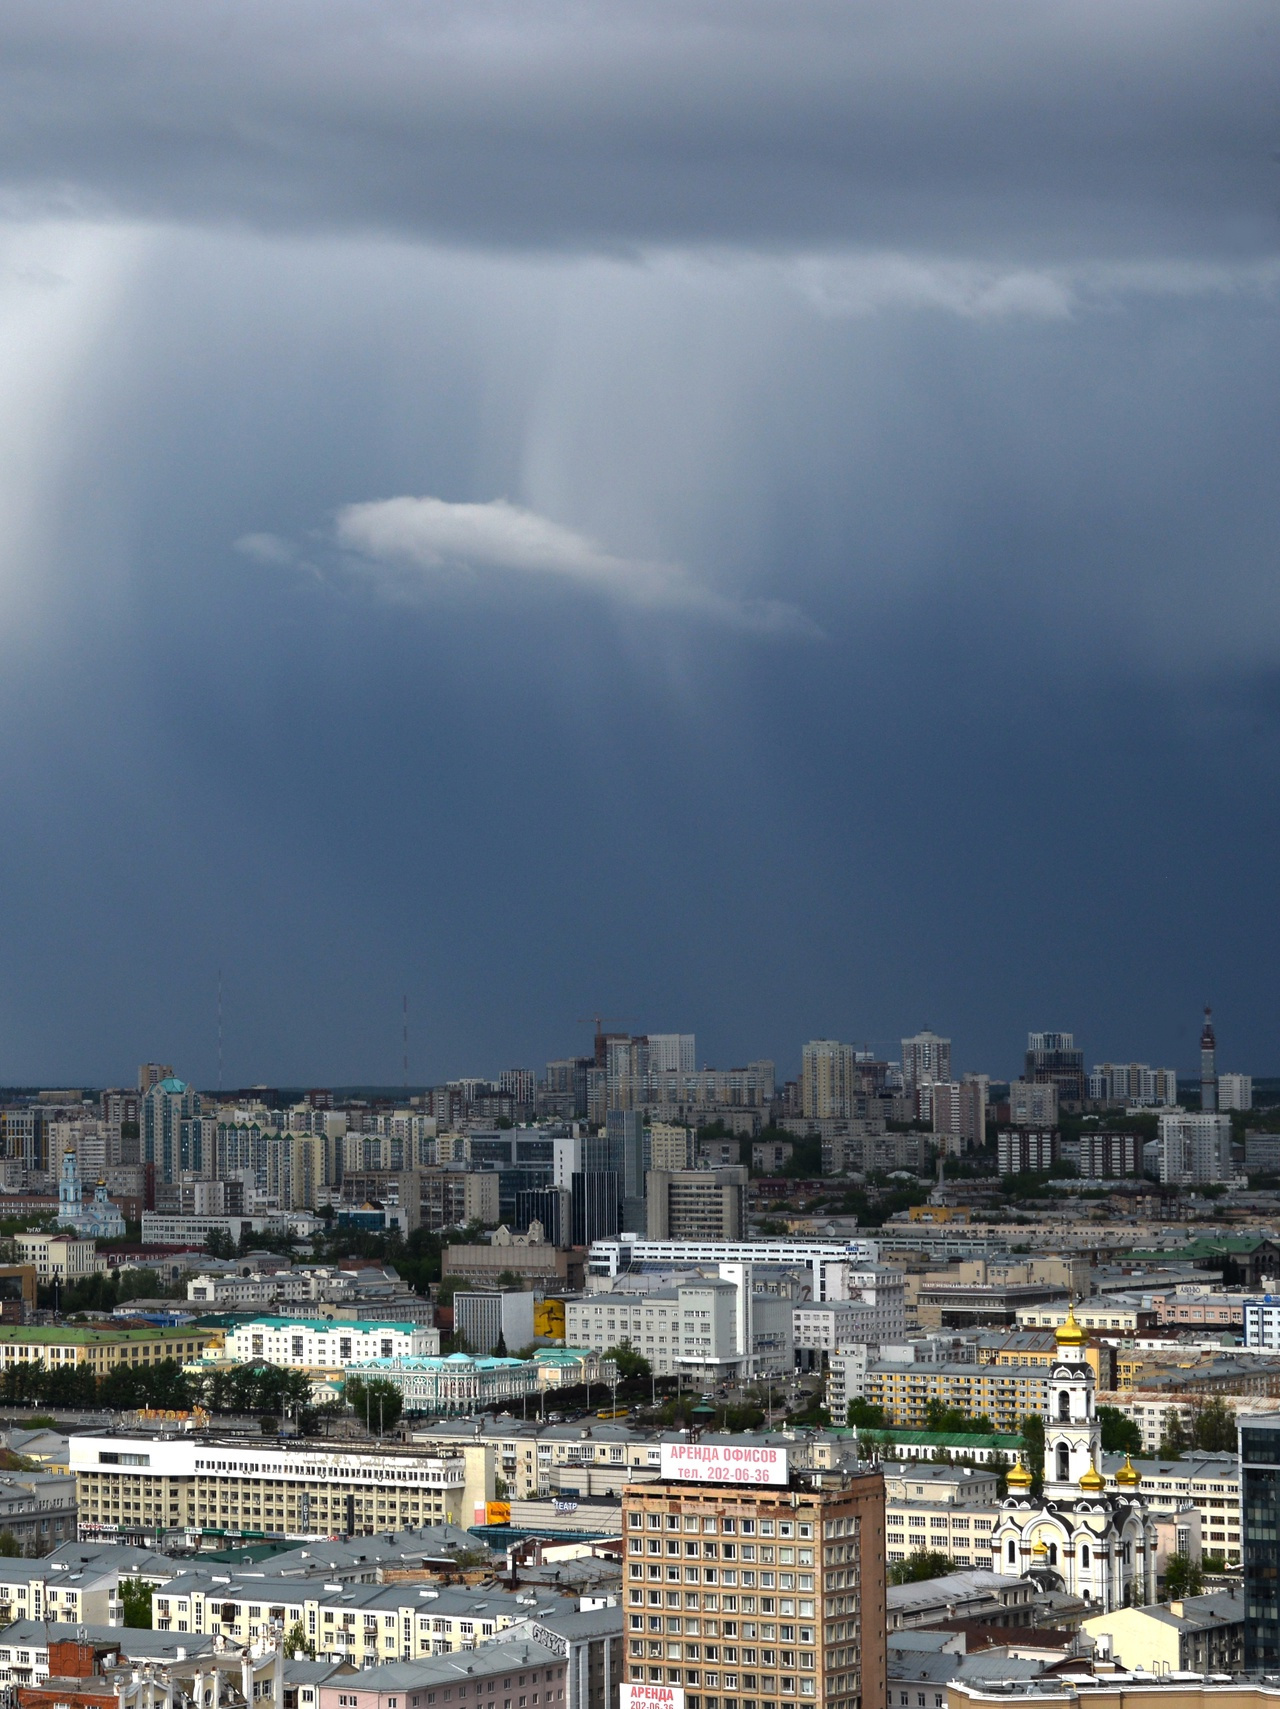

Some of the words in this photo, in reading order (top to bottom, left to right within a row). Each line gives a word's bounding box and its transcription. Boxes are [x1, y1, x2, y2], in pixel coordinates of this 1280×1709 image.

[670, 1445, 719, 1463] АРЕНДА
[723, 1447, 777, 1463] ОФИСОВ
[678, 1467, 703, 1479] тел.
[707, 1466, 770, 1483] 202-06-36
[555, 1502, 577, 1511] ТЕАТР
[631, 1686, 674, 1702] АРЕНДА
[631, 1701, 674, 1709] 202-06-36
